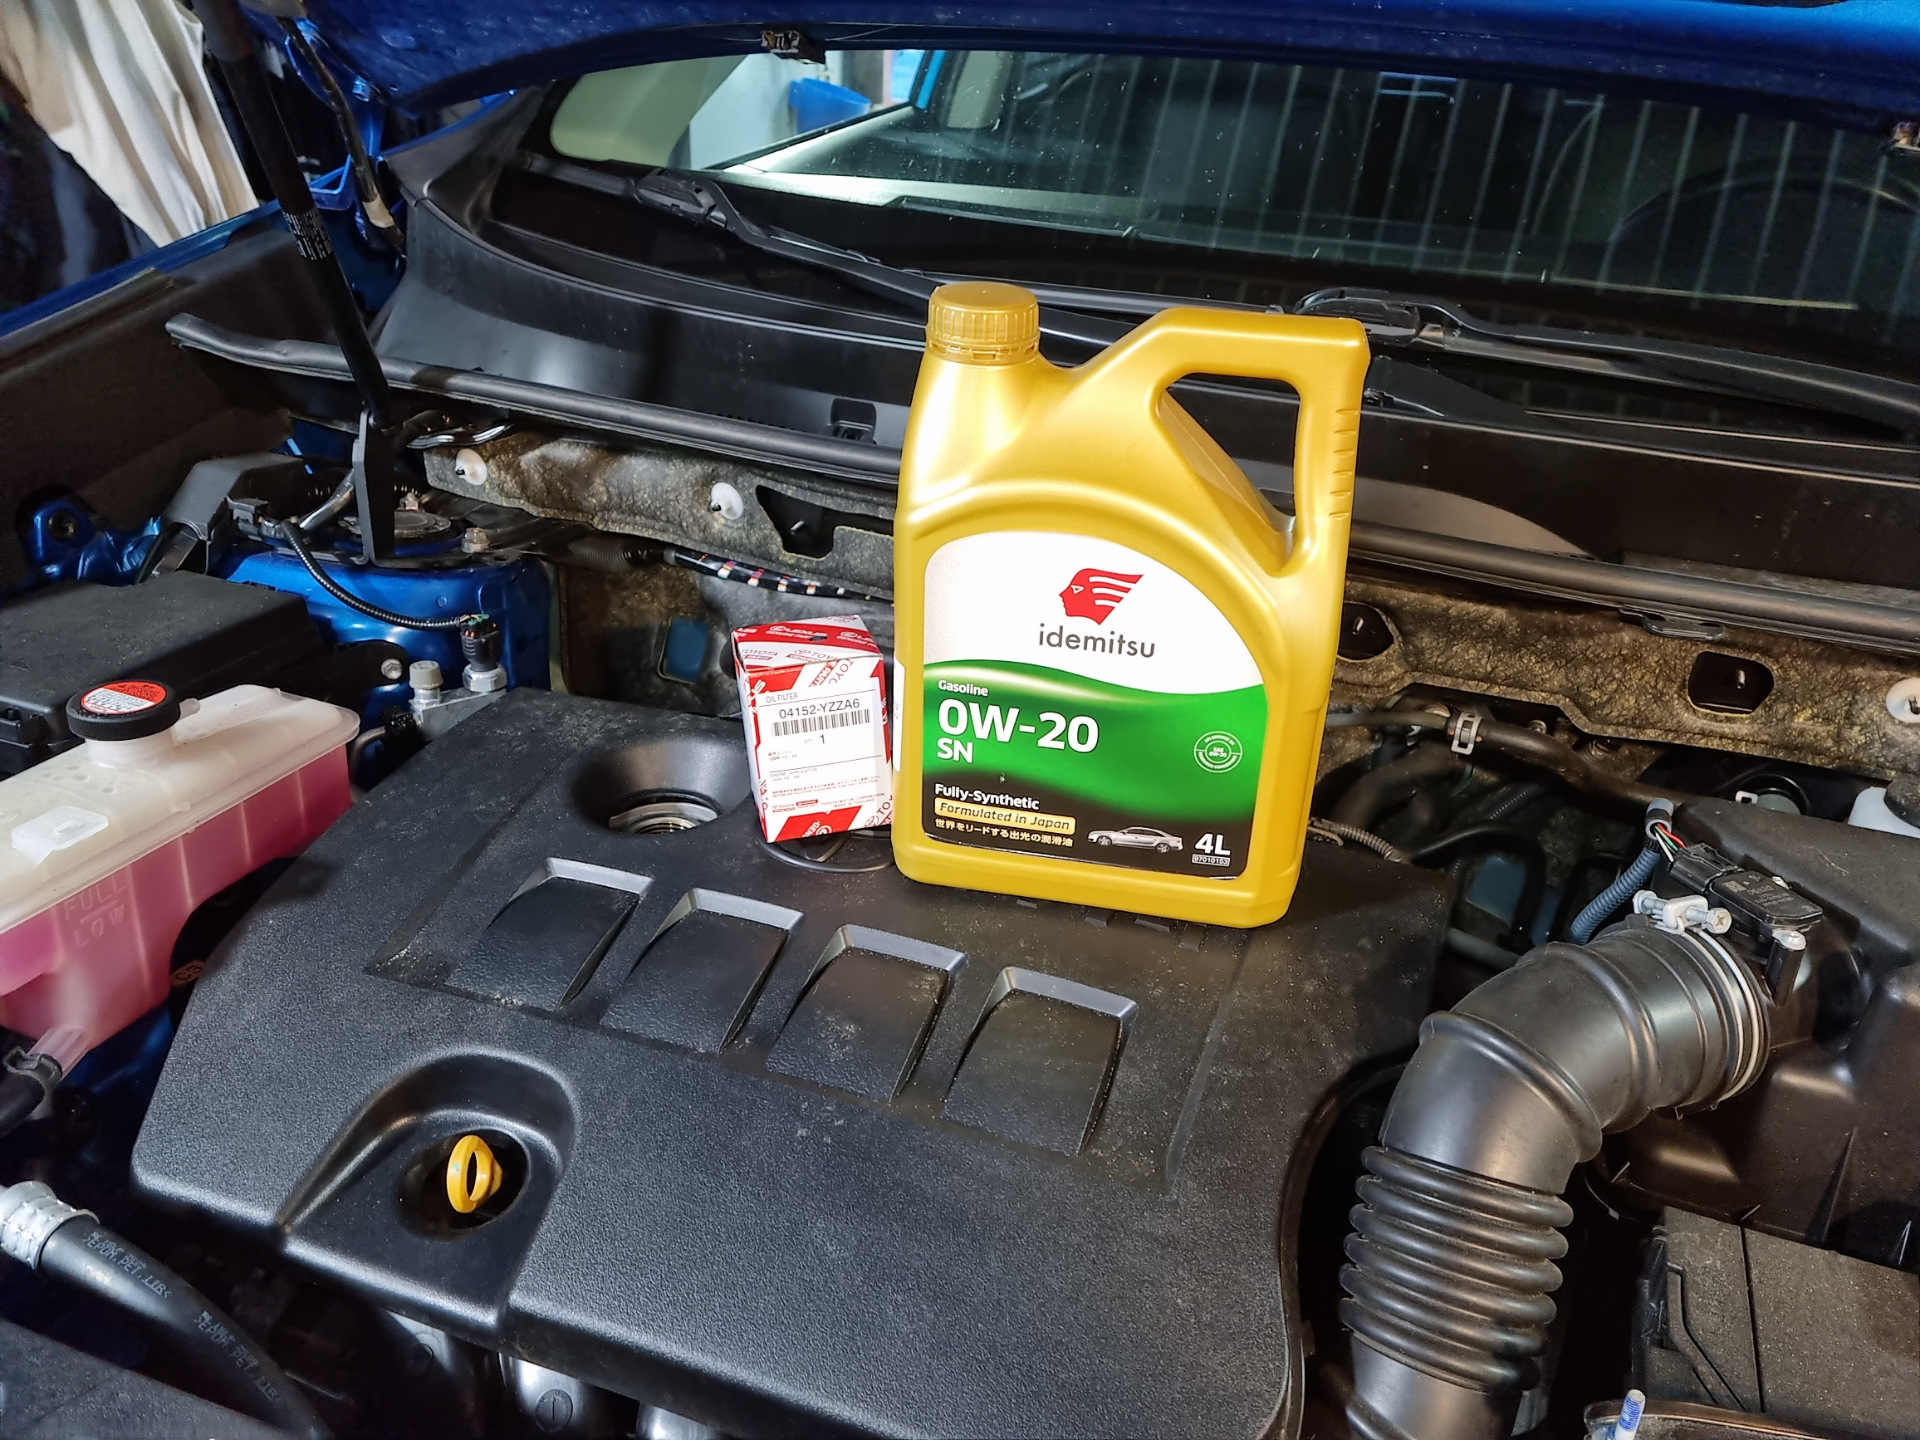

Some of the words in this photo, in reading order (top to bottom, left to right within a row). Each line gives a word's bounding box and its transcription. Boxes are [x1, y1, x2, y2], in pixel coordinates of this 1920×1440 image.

[1038, 623, 1156, 659] idemitsu
[765, 694, 777, 703] OIL
[777, 692, 798, 701] FILTER
[937, 679, 989, 698] Gasoline
[779, 698, 860, 720] 04152-YZZA6
[820, 734, 825, 744] 1
[937, 698, 1099, 754] 0W-20
[936, 738, 974, 763] SN
[934, 783, 1040, 811] Fully-Synthetic
[939, 802, 1012, 822] Formulated
[1015, 813, 1027, 824] in
[1029, 816, 1070, 831] Japan
[934, 818, 1074, 848] 世界をリードする出光の潤滑油
[1194, 833, 1231, 856] 4L
[64, 875, 128, 920] FULL
[73, 903, 126, 948] LOW
